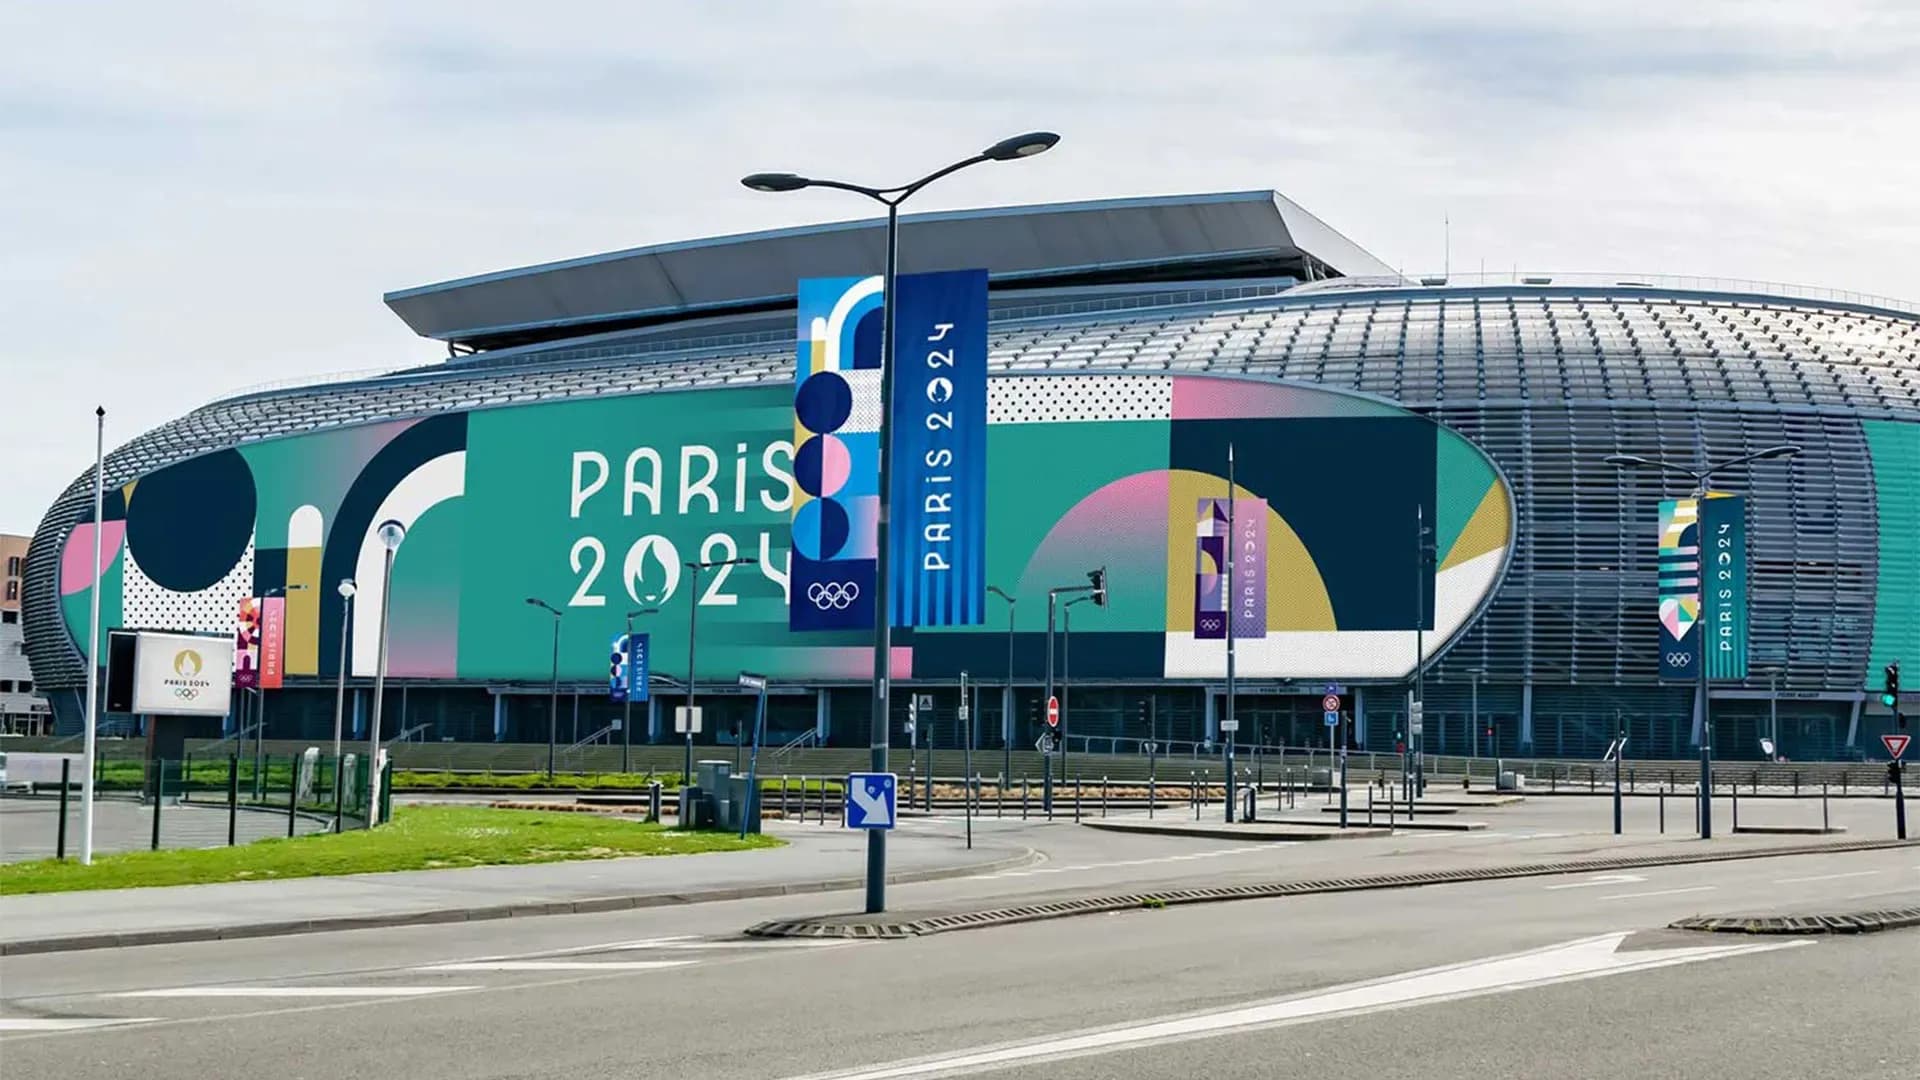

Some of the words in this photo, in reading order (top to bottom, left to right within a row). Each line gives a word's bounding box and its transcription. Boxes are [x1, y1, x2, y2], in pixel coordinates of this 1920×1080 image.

[926, 323, 955, 431] 2024
[567, 532, 792, 606] 2024
[1244, 519, 1256, 562] 2024
[1718, 524, 1732, 580] 2024
